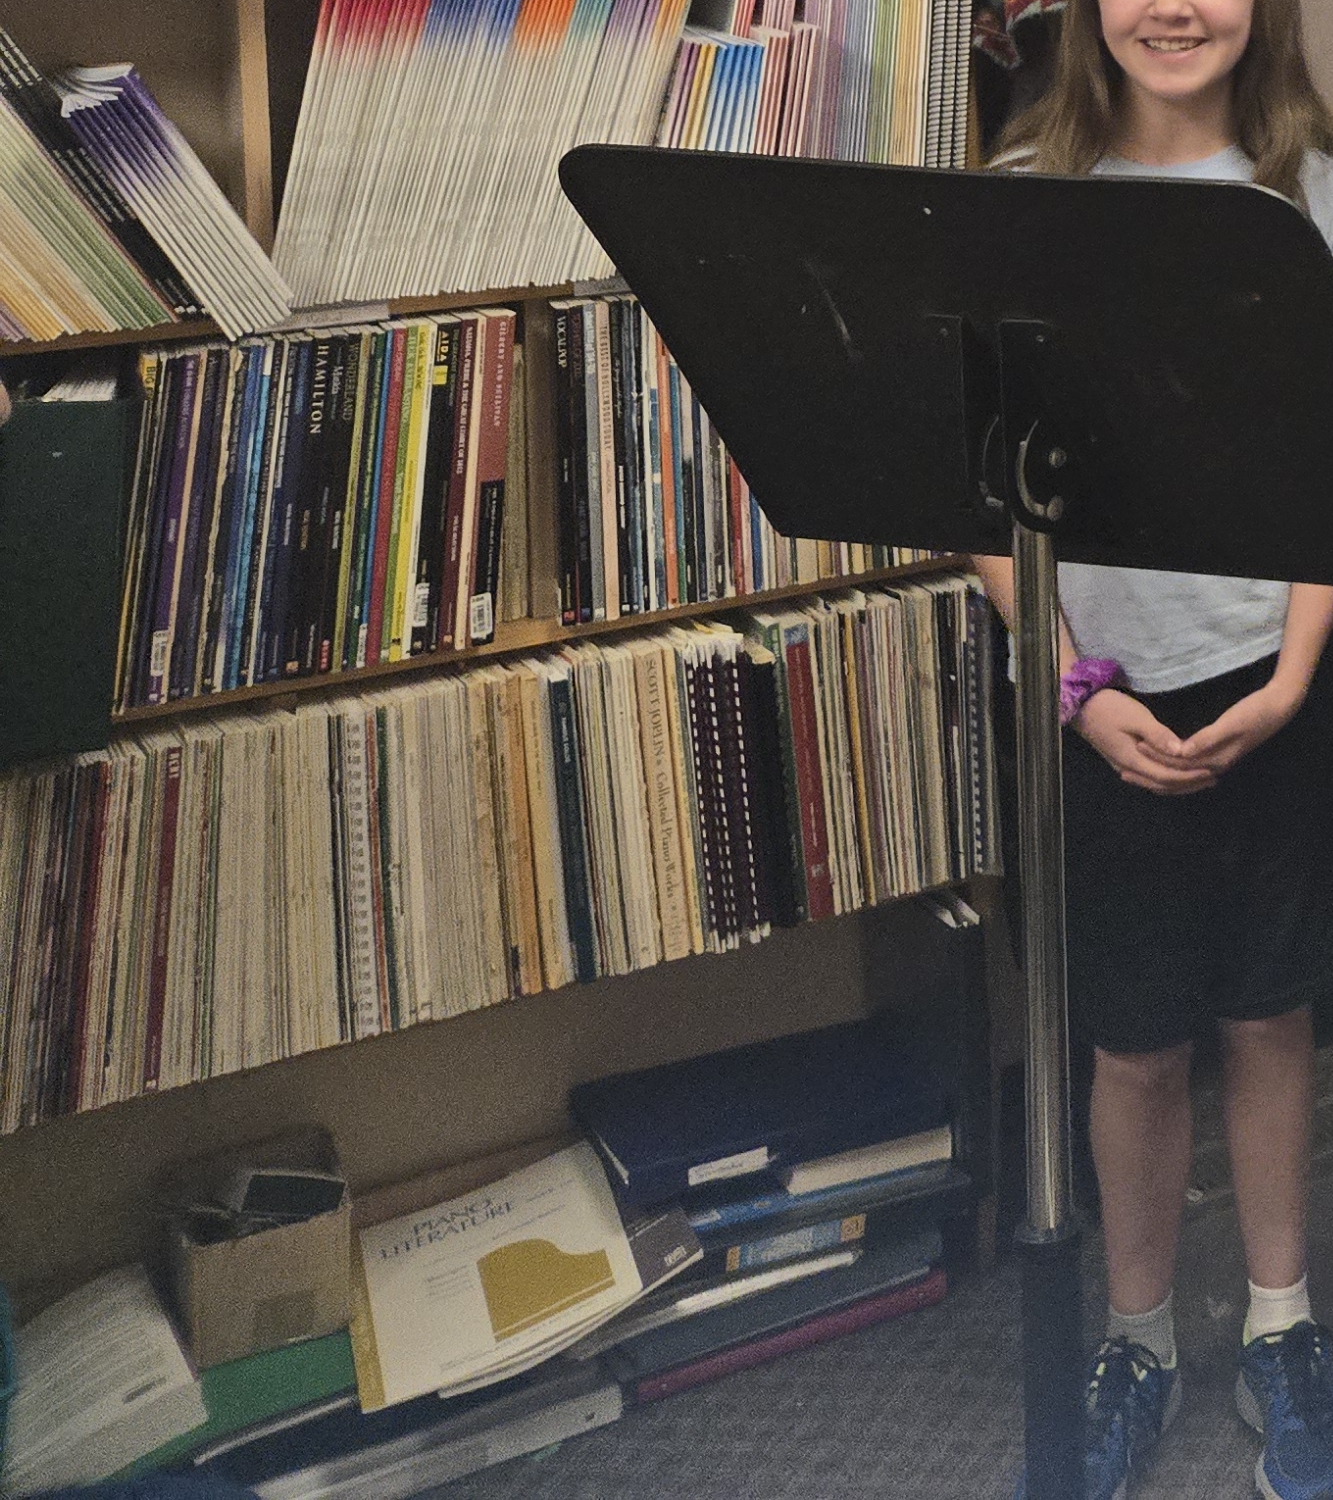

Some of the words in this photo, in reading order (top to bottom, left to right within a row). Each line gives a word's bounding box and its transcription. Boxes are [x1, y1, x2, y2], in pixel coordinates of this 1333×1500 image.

[440, 331, 449, 362] AIDA
[600, 342, 608, 360] BEST
[340, 342, 359, 422] WONDERLAND
[495, 363, 504, 381] AND
[601, 362, 608, 371] OF
[308, 344, 329, 435] HAMILTON
[601, 374, 610, 422] HOLLYWOOD
[603, 424, 611, 450] TODAY
[645, 658, 661, 705] SCOTT
[649, 706, 666, 756] JOPLIN
[656, 770, 673, 824] Collected
[661, 826, 676, 862] Piano
[664, 862, 679, 898] Works
[380, 1201, 514, 1260] LITERATURE
[412, 1199, 494, 1236] PIANO
